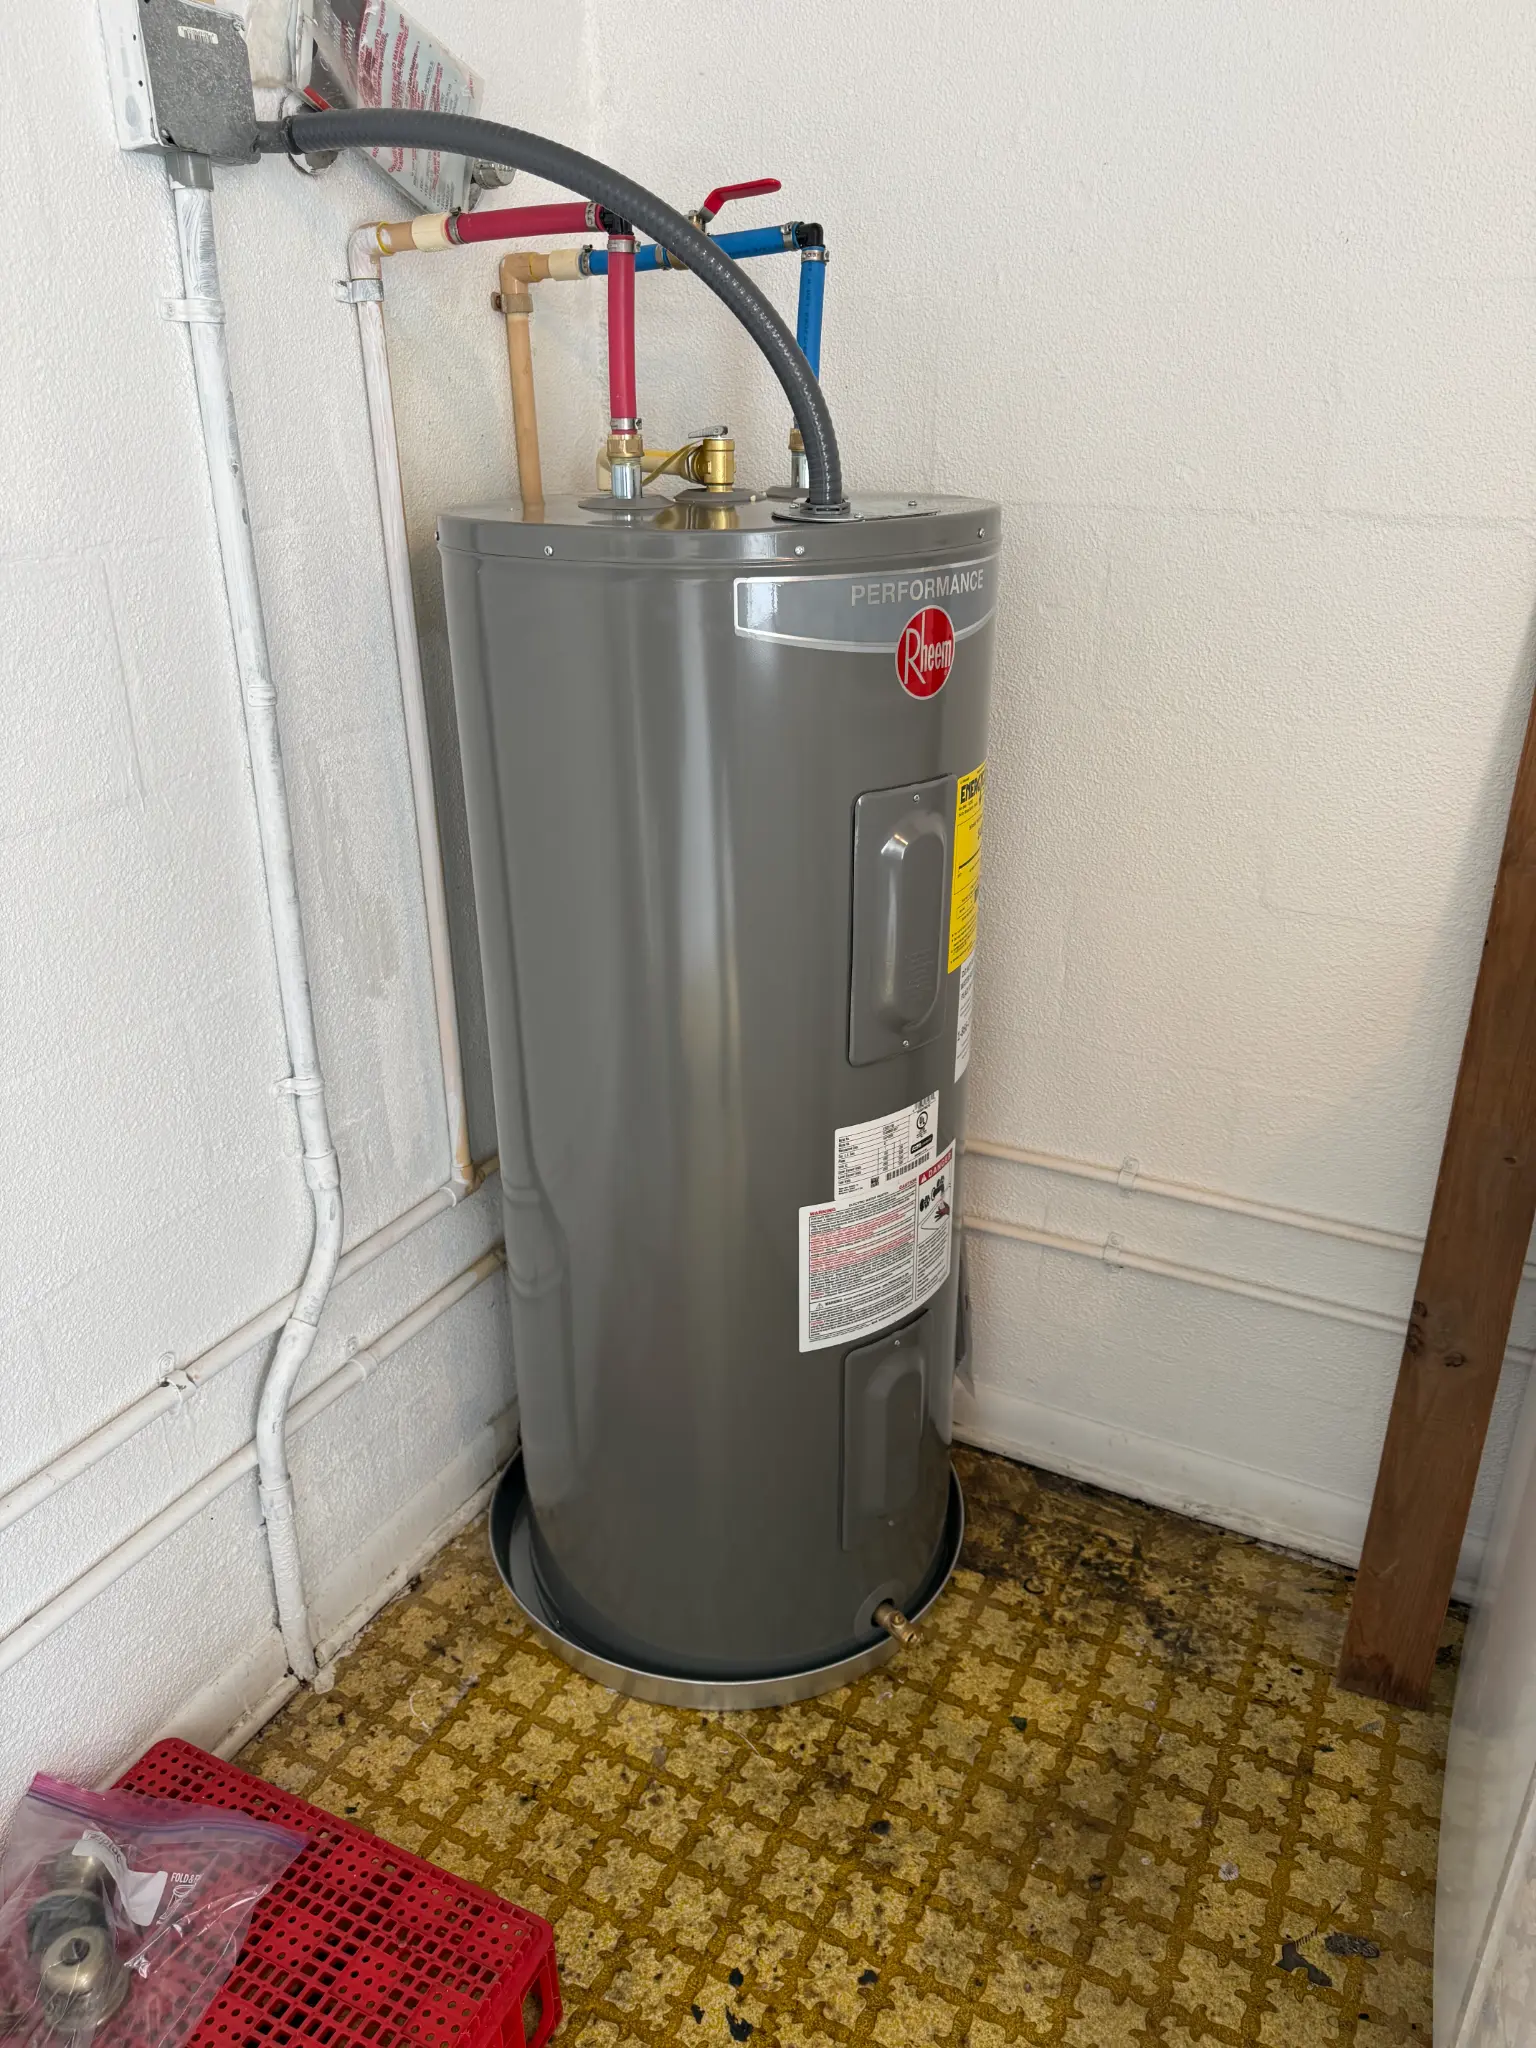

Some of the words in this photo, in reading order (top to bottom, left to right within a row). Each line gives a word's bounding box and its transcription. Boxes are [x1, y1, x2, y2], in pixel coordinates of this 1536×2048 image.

[851, 568, 984, 606] PERFORMANCE
[904, 612, 952, 684] Rheem
[928, 1152, 952, 1178] DANGER
[810, 1207, 836, 1216] WARNING
[170, 1872, 189, 1883] FOLD
